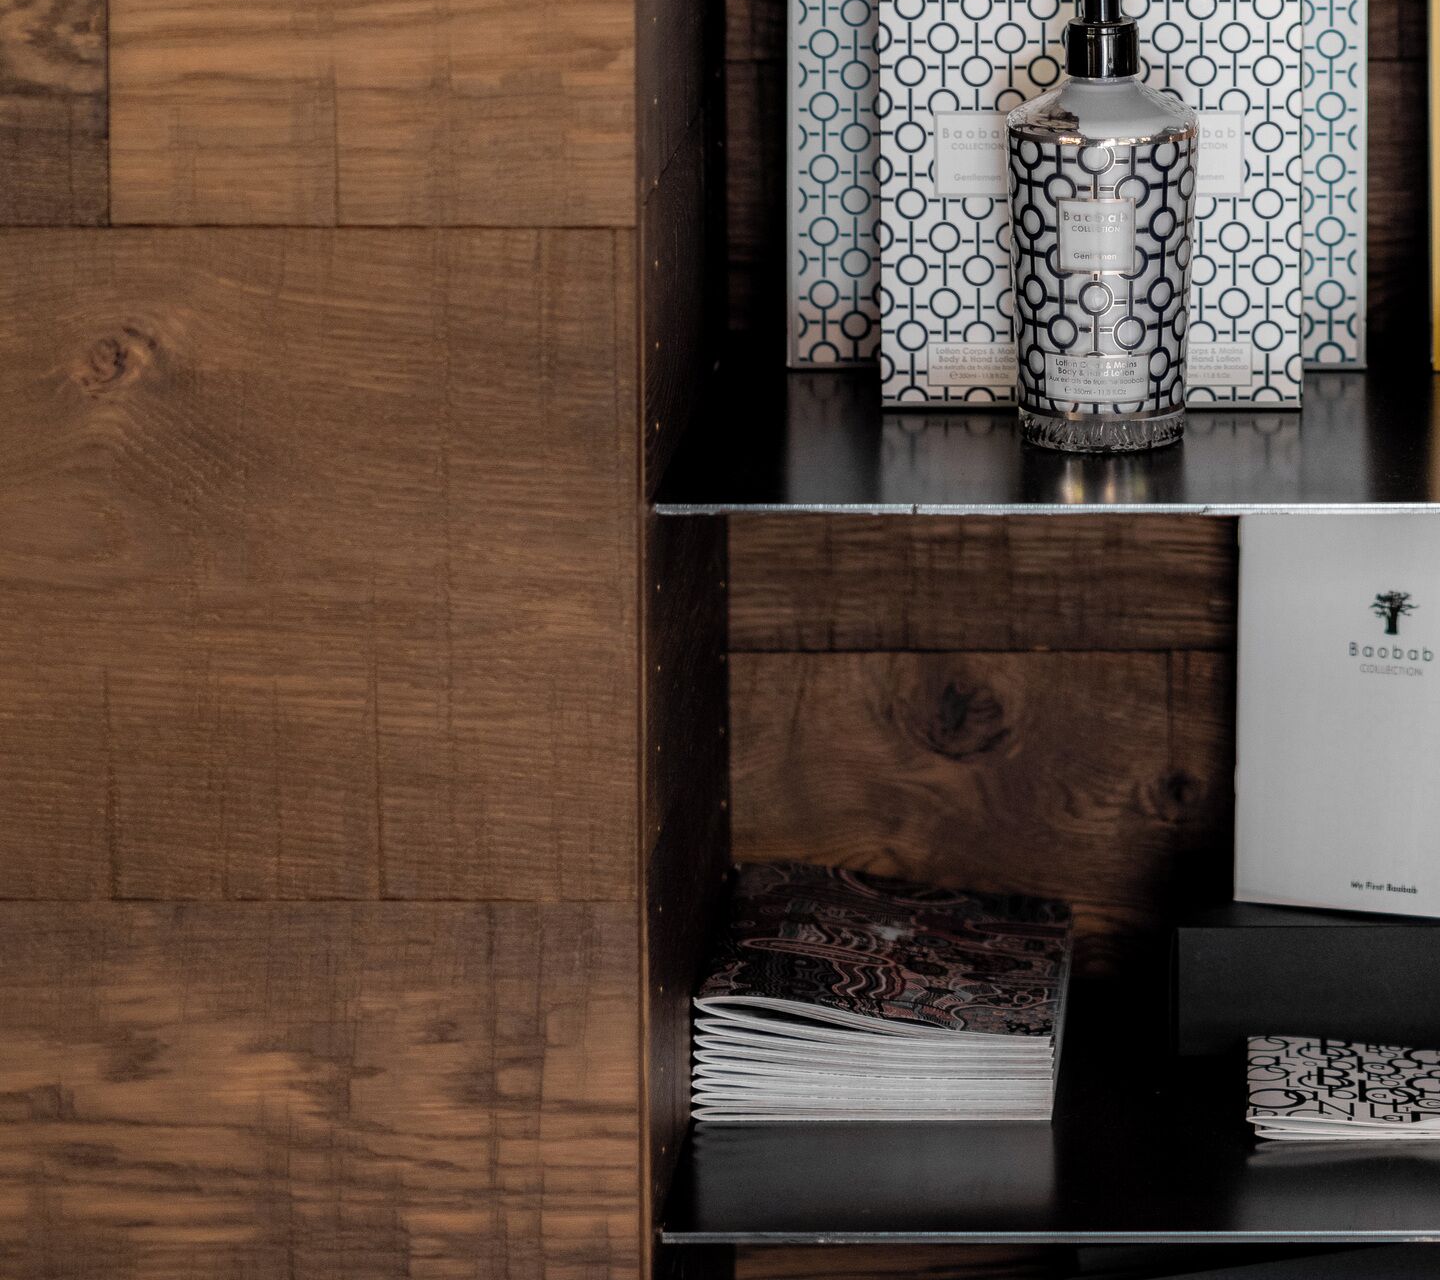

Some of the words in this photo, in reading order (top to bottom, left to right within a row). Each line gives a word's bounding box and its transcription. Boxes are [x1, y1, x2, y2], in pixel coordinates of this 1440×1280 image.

[942, 128, 1000, 139] Baoba
[1348, 641, 1434, 662] Baobab
[1359, 664, 1423, 676] COLLECTION
[1365, 881, 1385, 891] First
[1386, 884, 1418, 894] Baobab
